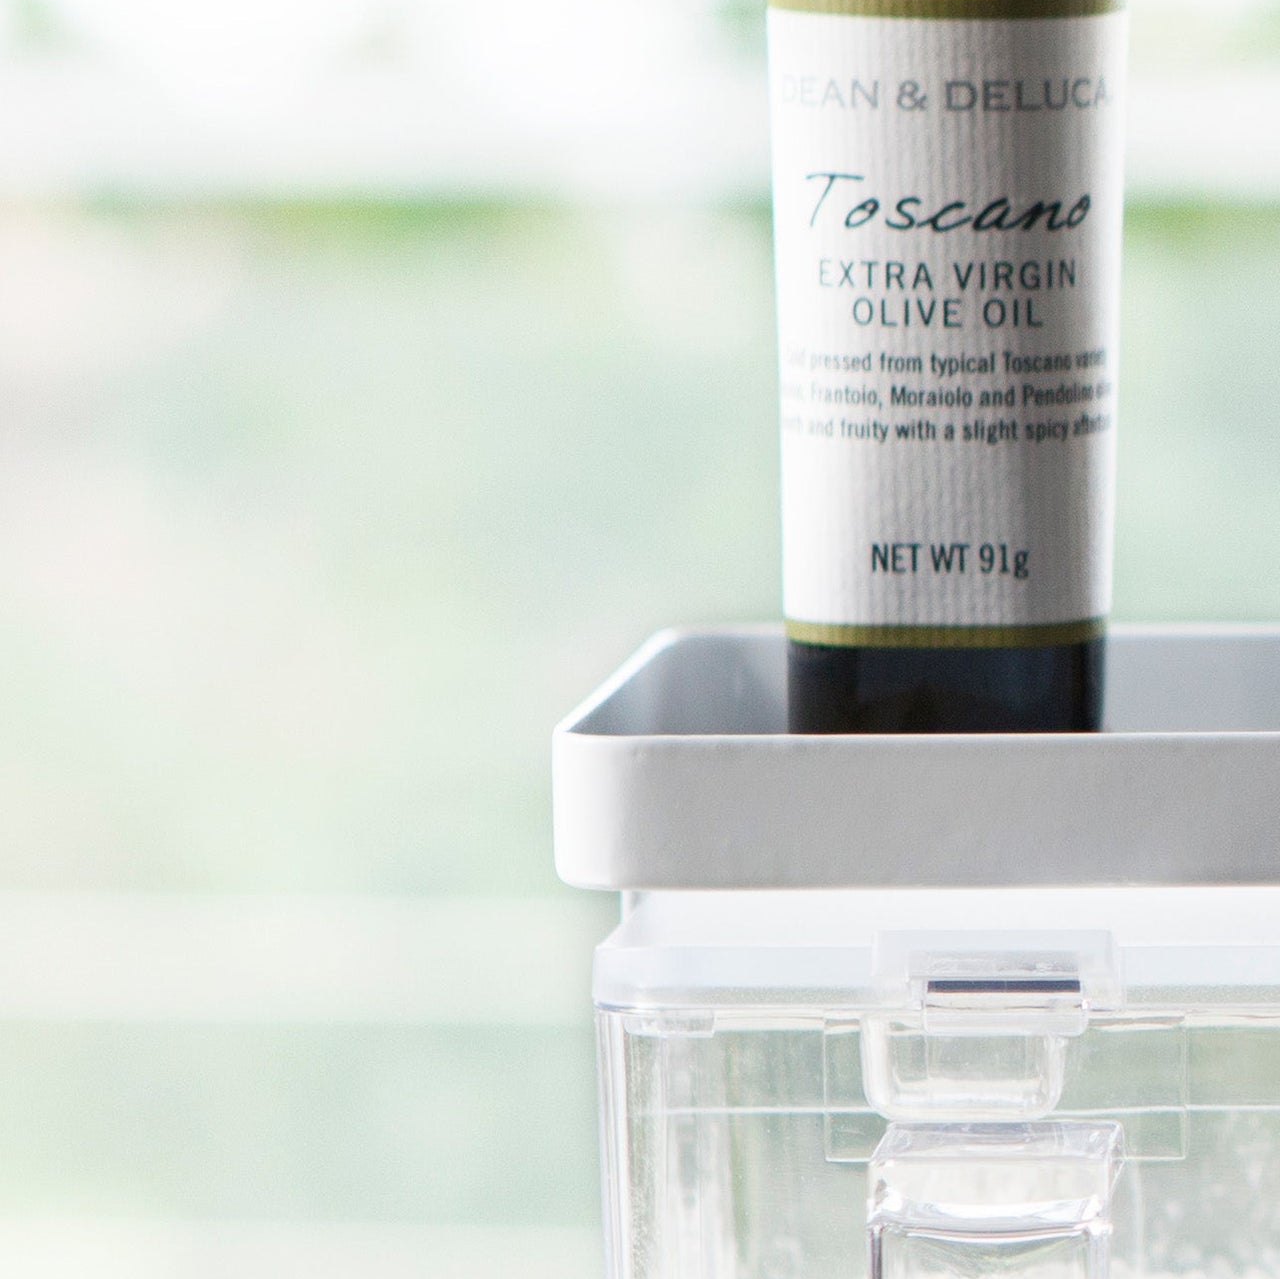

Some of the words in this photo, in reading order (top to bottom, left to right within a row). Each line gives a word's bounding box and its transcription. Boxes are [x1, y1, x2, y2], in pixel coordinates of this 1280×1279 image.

[782, 74, 879, 111] DEAN
[896, 79, 928, 112] &
[945, 75, 1111, 112] DELUCA
[806, 172, 1091, 233] Toscano
[820, 259, 933, 290] EXTRA
[953, 259, 1077, 291] VIRGIN
[853, 297, 963, 328] OLIVE
[982, 297, 1044, 328] OIL
[810, 352, 872, 374] pressed
[880, 352, 923, 373] from
[931, 352, 995, 377] typical
[890, 385, 973, 408] Moraiolo
[980, 385, 1015, 407] and
[841, 419, 888, 443] fruity
[895, 420, 936, 441] with
[944, 423, 955, 441] a
[962, 419, 1018, 445] slight
[1026, 418, 1068, 443] spicy
[871, 544, 921, 573] NET
[930, 544, 970, 573] WT
[978, 544, 1029, 579] 91g
